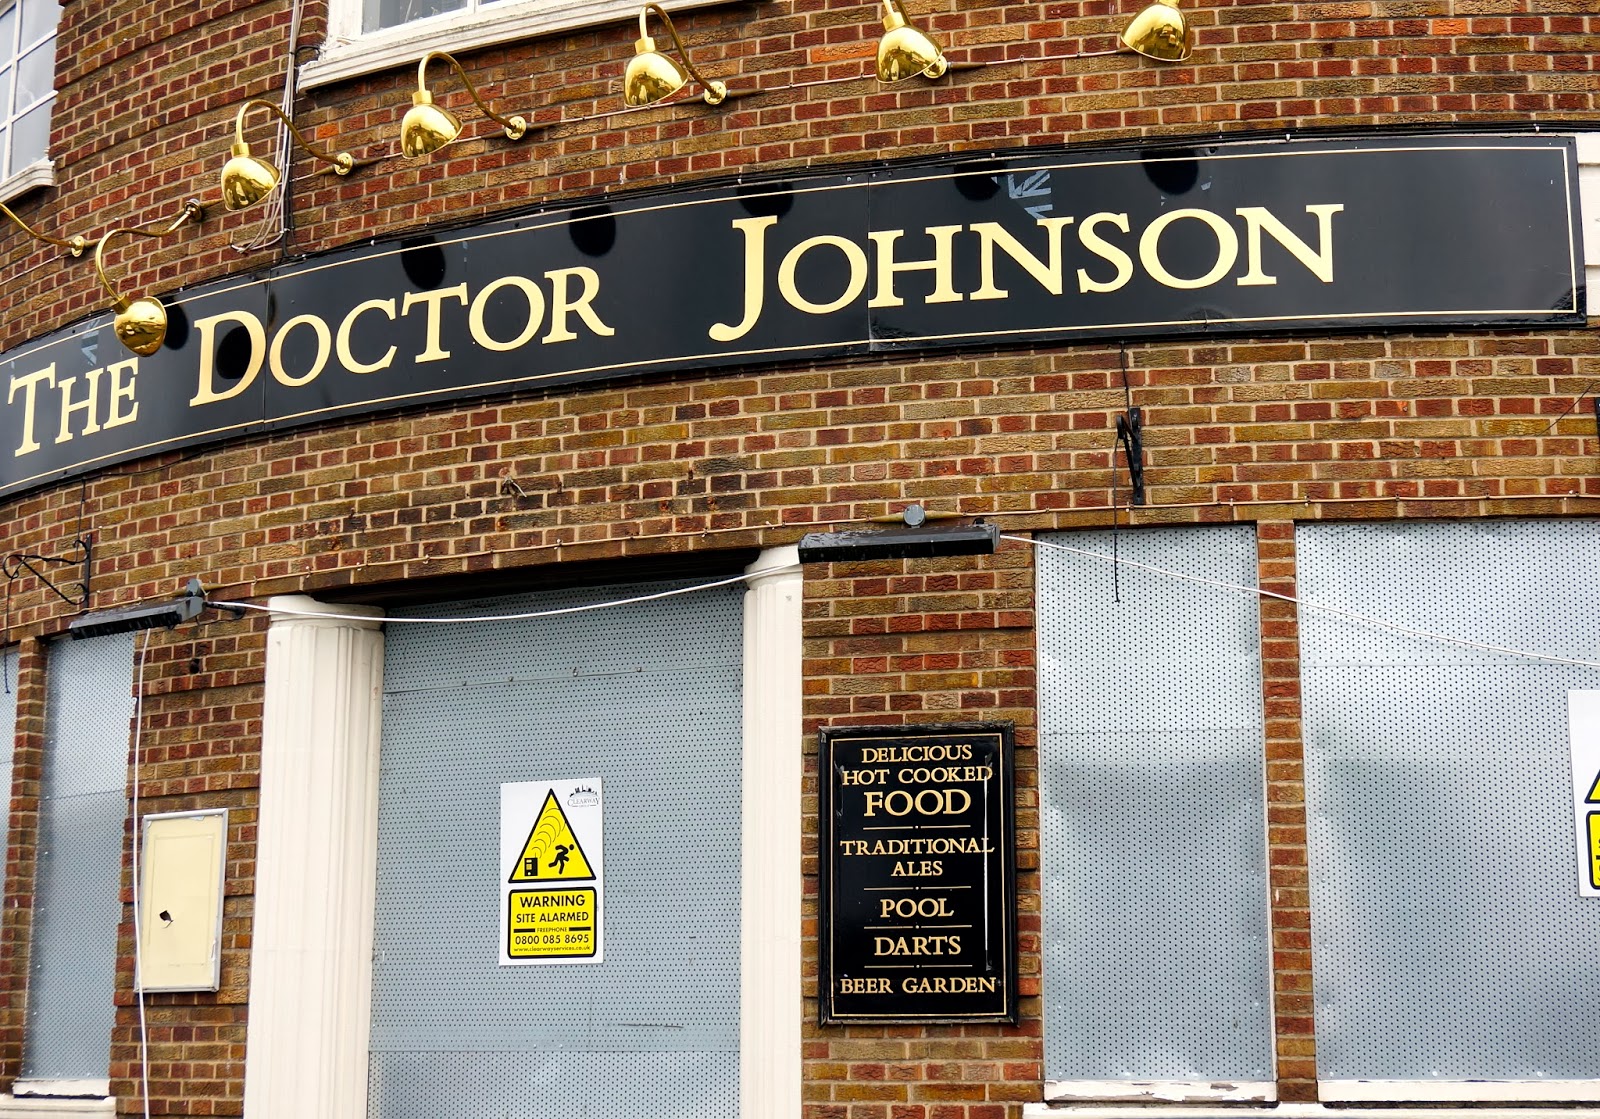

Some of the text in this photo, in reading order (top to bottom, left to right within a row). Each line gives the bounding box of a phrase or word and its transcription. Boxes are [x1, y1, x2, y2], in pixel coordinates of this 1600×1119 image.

[9, 203, 1344, 457] THE DOCTOR JOHNSON
[861, 744, 973, 764] DELICIOUS
[842, 766, 993, 786] HOT COOKED
[567, 797, 599, 806] CLEARWAY
[863, 789, 972, 817] FOOD
[840, 838, 995, 856] TRADITIONAL
[891, 860, 943, 877] ALES
[520, 894, 585, 907] WARNING
[880, 898, 955, 918] POOL
[516, 912, 589, 923] SITE ALARMED
[515, 934, 589, 945] 0800 085 8695
[874, 936, 962, 956] DARTS
[840, 976, 997, 994] BEER GARDEN
